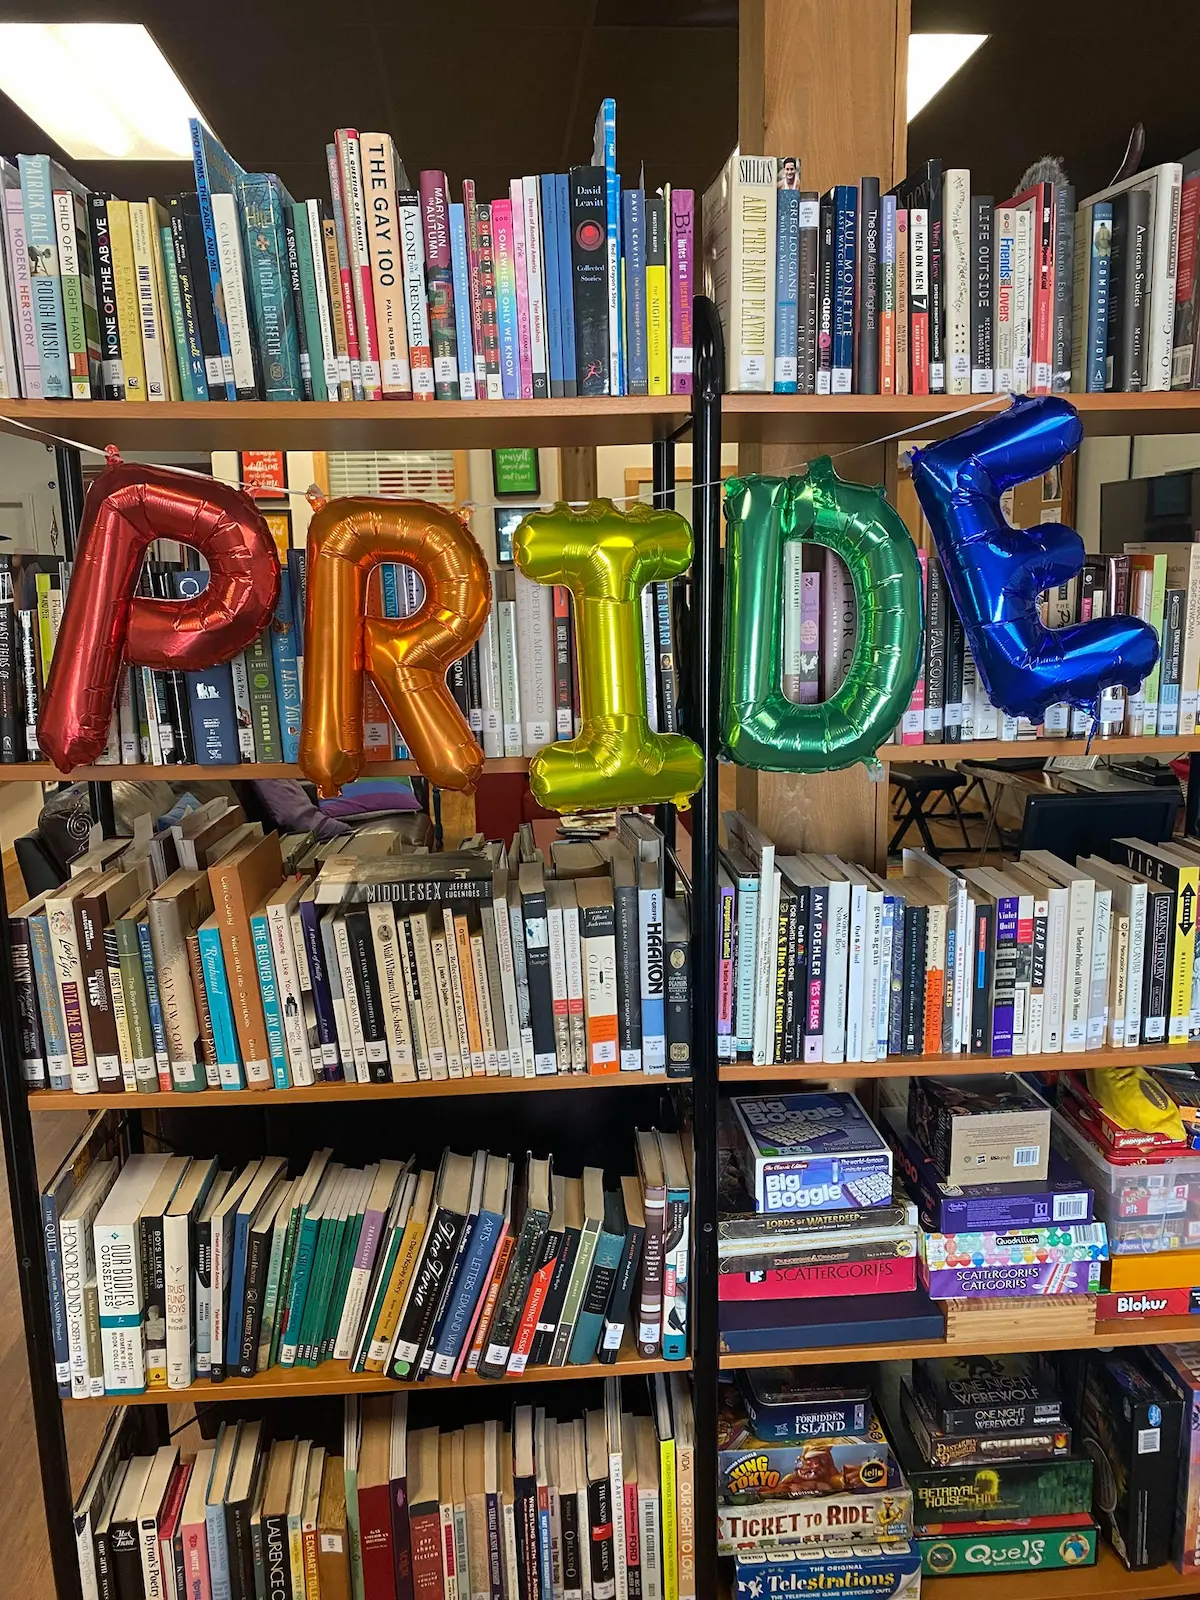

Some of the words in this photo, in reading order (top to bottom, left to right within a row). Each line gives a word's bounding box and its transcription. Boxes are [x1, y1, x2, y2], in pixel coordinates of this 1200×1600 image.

[369, 144, 387, 190] THE
[740, 160, 773, 184] SHILTS
[25, 161, 43, 208] PATRICK
[577, 186, 601, 195] David
[59, 197, 69, 231] CHILD
[435, 187, 444, 216] MARY
[575, 198, 603, 207] Leavitt
[743, 196, 766, 222] AND
[789, 199, 798, 224] GREG
[30, 210, 48, 241] GALE
[375, 200, 391, 241] GAY
[426, 206, 438, 259] AUTUMN
[437, 218, 447, 247] ANN
[845, 211, 854, 251] PAUL
[978, 205, 990, 241] LIFE
[63, 238, 72, 252] OF
[98, 217, 111, 262] ABOVE
[743, 228, 766, 254] THE
[915, 232, 923, 253] MEN
[1134, 225, 1146, 271] American
[14, 229, 27, 280] MODERN
[64, 255, 74, 273] MY
[378, 249, 394, 286] 100
[498, 228, 509, 294] SOMEWHERE
[577, 264, 604, 272] Collected
[788, 227, 799, 299] LOUGANIS
[917, 256, 923, 269] ON
[1001, 238, 1014, 279] Friends
[103, 265, 114, 295] THE
[258, 258, 269, 300] NICOLA
[742, 259, 766, 291] BAND
[916, 271, 924, 290] MEN
[978, 248, 990, 308] OUTSIDE
[37, 280, 55, 317] ROUGH
[67, 279, 79, 312] RIGHT
[843, 259, 853, 336] MONETTE
[913, 299, 926, 309] 7
[1097, 260, 1107, 321] COMFORT
[1134, 274, 1145, 308] Studies
[20, 285, 35, 347] HERSTORY
[104, 297, 114, 314] OF
[408, 274, 423, 346] TRENCHES
[503, 296, 511, 324] ONLY
[999, 287, 1013, 322] Lovers
[70, 318, 81, 349] HAND
[263, 307, 281, 356] GRIFFITH
[506, 326, 512, 343] WE
[742, 299, 765, 344] PLAYED
[41, 321, 59, 359] MUSIC
[103, 317, 118, 354] NONE
[1094, 340, 1103, 362] JOY
[38, 393, 1160, 813] PRIDE
[657, 582, 669, 601] TIG
[658, 605, 671, 646] NOTARO
[929, 629, 944, 709] FALCONER
[280, 669, 298, 700] MISS
[259, 705, 271, 741] CHABON
[284, 703, 300, 725] YOU
[1127, 850, 1164, 882] VICE
[366, 882, 442, 902] MIDDLESEX
[445, 890, 480, 899] EUGENIDES
[449, 883, 477, 891] JEFFREY
[813, 894, 824, 919] AMY
[1158, 900, 1168, 940] MAKING
[253, 924, 266, 941] THE
[999, 921, 1016, 929] Quill
[1036, 919, 1046, 949] LEAP
[256, 943, 272, 981] BELOVED
[647, 922, 664, 996] HAAKON
[812, 922, 823, 977] POEHLER
[1154, 942, 1166, 980] HISTORY
[206, 946, 221, 995] Rimbaud
[1034, 952, 1045, 985] YEAR
[62, 982, 76, 1003] RITA
[262, 984, 275, 1002] SON
[811, 980, 822, 1001] YES
[66, 1005, 82, 1029] MAE
[266, 1012, 279, 1027] JAY
[810, 999, 821, 1030] PLEASE
[72, 1030, 87, 1066] BROWN
[270, 1031, 282, 1058] QUINN
[740, 1100, 788, 1115] Big
[749, 1104, 845, 1125] Boggle
[790, 1161, 807, 1169] Edition
[874, 1164, 889, 1172] game
[765, 1173, 800, 1192] Big
[767, 1184, 842, 1209] Boggle
[765, 1219, 796, 1229] LORDS
[806, 1213, 861, 1225] WATERDEEP
[62, 1226, 78, 1270] HONOR
[154, 1230, 162, 1252] BOYS
[429, 1221, 456, 1258] Vice
[996, 1235, 1039, 1245] Quadrillion
[111, 1244, 132, 1268] OUR
[154, 1255, 162, 1274] LIKE
[101, 1245, 115, 1307] OURSELVES
[113, 1268, 135, 1310] BODIES,
[156, 1279, 164, 1289] US
[167, 1285, 185, 1294] TRUST
[414, 1258, 444, 1307] Versa
[666, 1268, 676, 1295] brother
[65, 1272, 82, 1318] BOUND:
[168, 1295, 185, 1303] FUND
[526, 1287, 543, 1321] RUNNING
[1117, 1297, 1168, 1315] Blokus
[168, 1305, 186, 1314] BOYS
[72, 1320, 80, 1343] JOSEPH
[949, 1379, 984, 1393] ONE
[985, 1376, 1033, 1390] NIGHT
[953, 1388, 1040, 1406] WEREWOLF
[796, 1414, 845, 1423] FORBIDDEN
[974, 1410, 997, 1420] ONE
[998, 1407, 1026, 1418] NIGHT
[974, 1417, 1026, 1429] WEREWOLF
[795, 1421, 846, 1435] ISLAND
[681, 1452, 690, 1471] VIDA
[730, 1455, 769, 1480] KING
[680, 1482, 692, 1505] OUR
[728, 1469, 780, 1494] TOKYO
[918, 1485, 975, 1499] BETRAYAL
[926, 1496, 963, 1508] HOUSE
[681, 1508, 692, 1536] RIGHT
[726, 1513, 801, 1538] TICKET
[803, 1513, 821, 1526] TO
[827, 1505, 874, 1526] RIDE
[266, 1518, 286, 1589] LAURENCE
[306, 1533, 316, 1572] ECKHART
[682, 1538, 692, 1557] TO
[964, 1539, 1045, 1566] Quelf
[681, 1557, 693, 1580] LOVE
[309, 1572, 318, 1600] TOLLE
[767, 1572, 895, 1593] Telestrations
[822, 1590, 840, 1598] GAME
